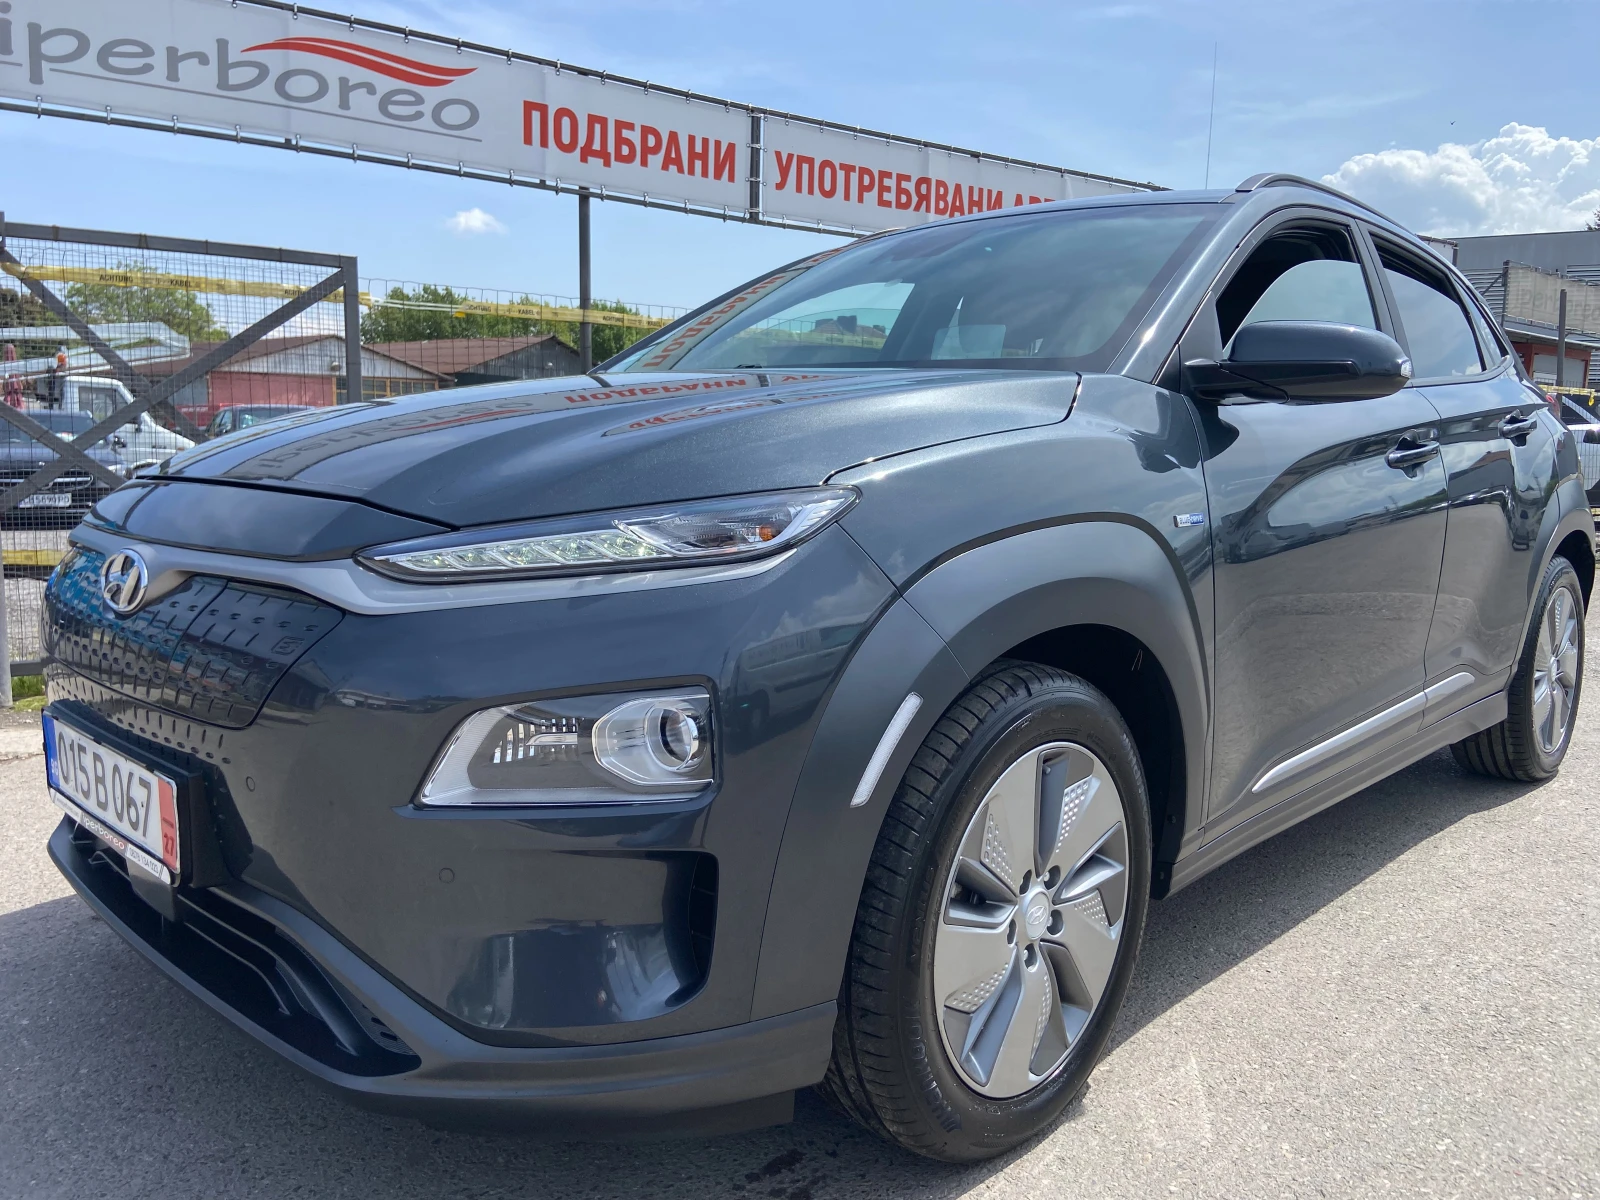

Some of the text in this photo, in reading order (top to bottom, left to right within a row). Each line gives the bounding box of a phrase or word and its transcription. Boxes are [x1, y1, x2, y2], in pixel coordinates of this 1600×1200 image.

[0, 0, 480, 131] iperboreo
[522, 100, 1003, 218] ПОДБРАНИ УПОТРЕБЯВАНИ
